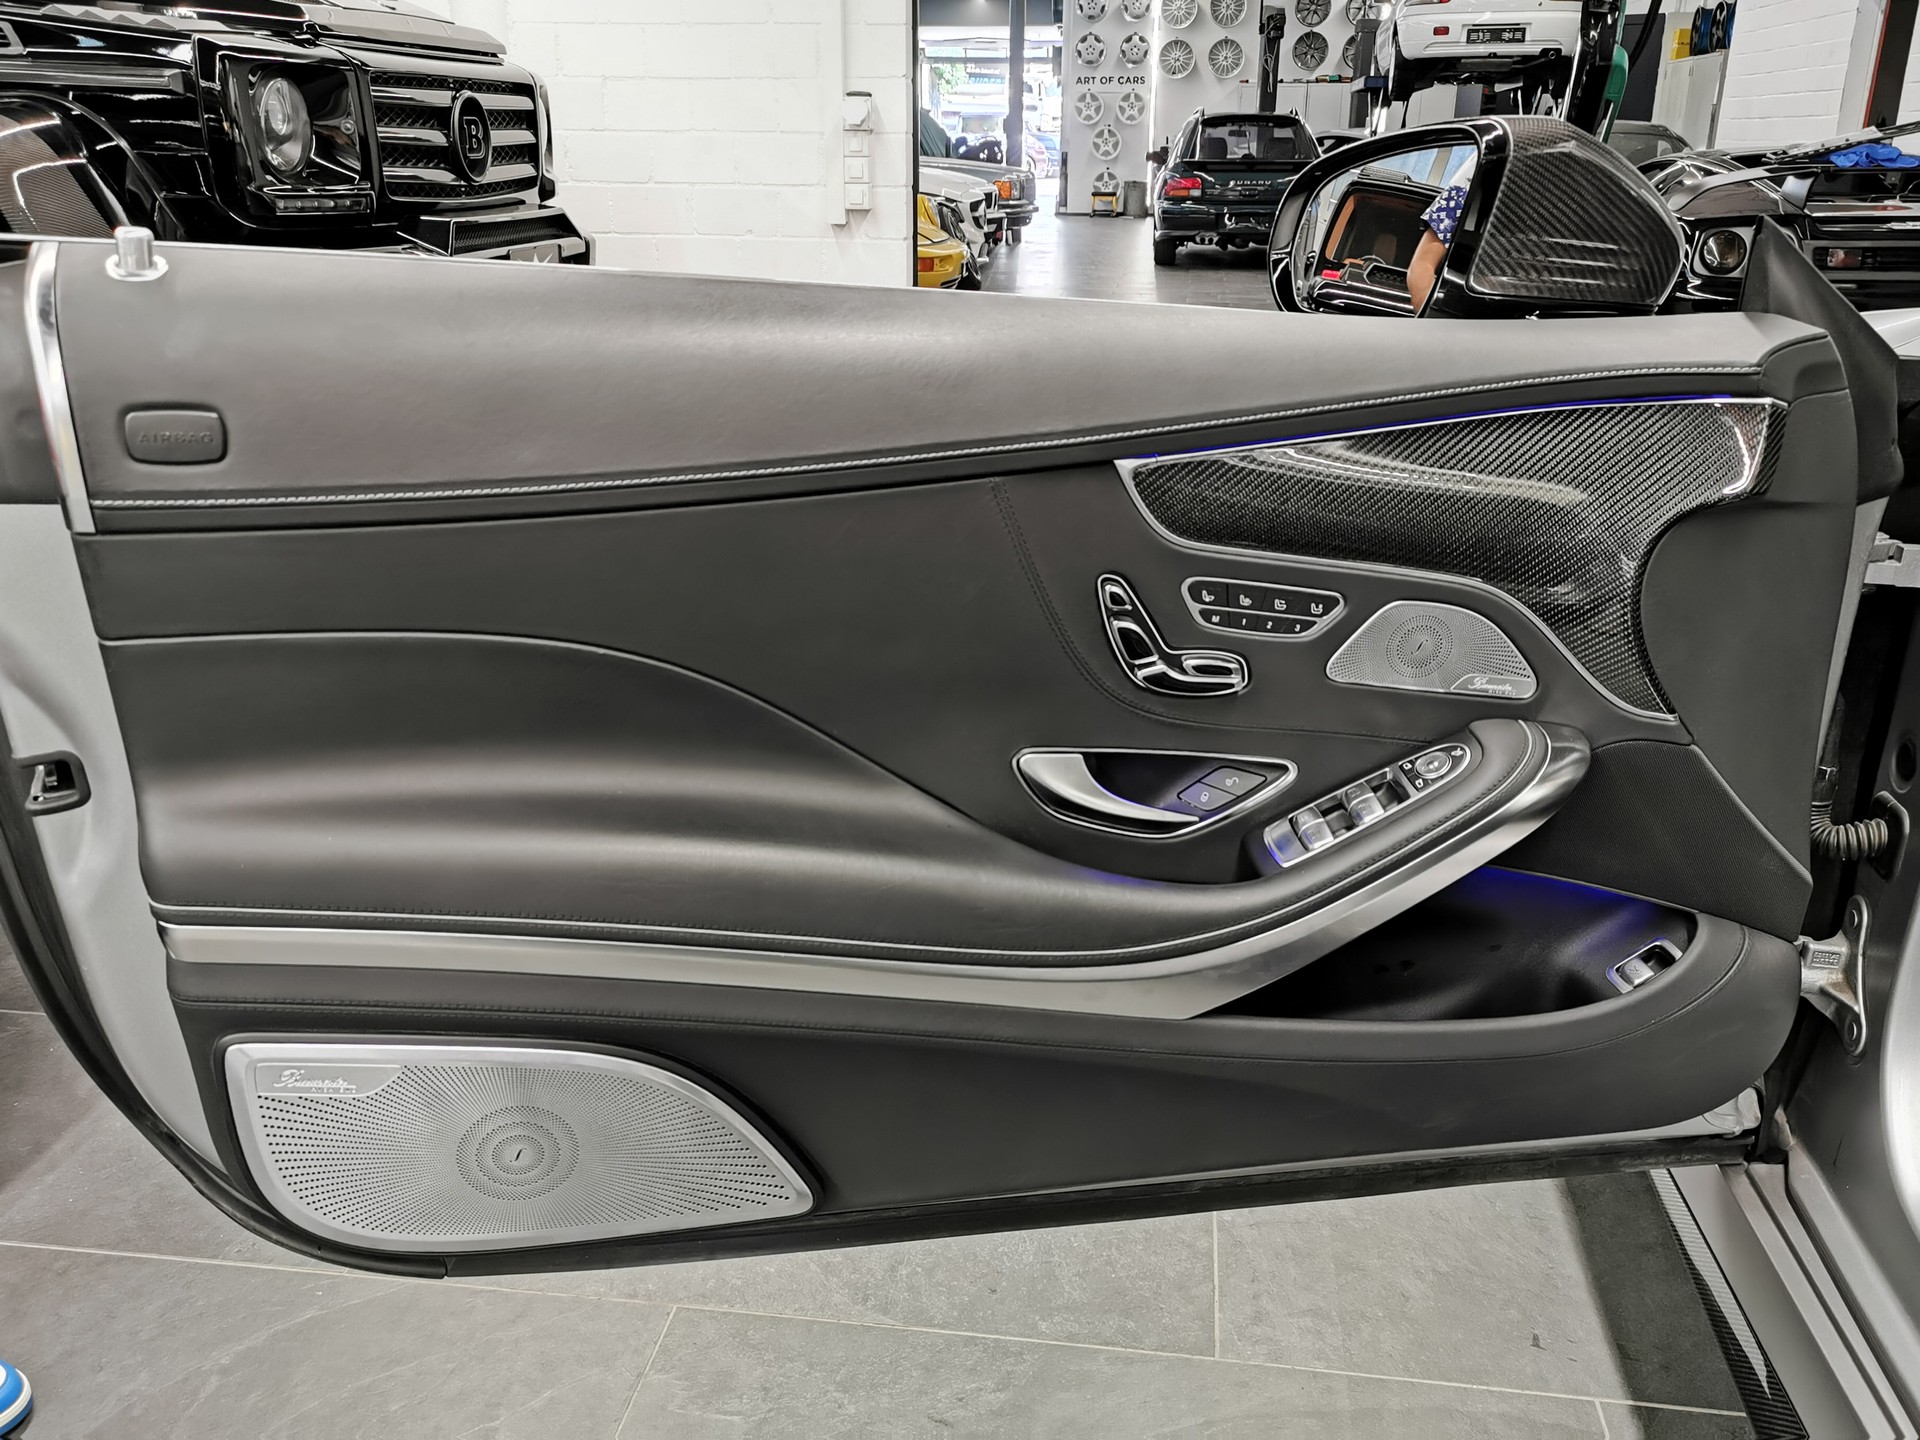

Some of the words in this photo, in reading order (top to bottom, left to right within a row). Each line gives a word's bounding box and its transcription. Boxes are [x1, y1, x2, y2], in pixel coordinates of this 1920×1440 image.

[1076, 76, 1096, 85] ART
[1100, 76, 1114, 85] OF
[1117, 76, 1146, 85] CARS
[463, 116, 485, 159] B
[139, 432, 216, 445] AIRBAG
[1211, 615, 1220, 623] M
[1242, 618, 1247, 626] 1
[1266, 620, 1273, 629] 2
[1294, 624, 1301, 632] 3
